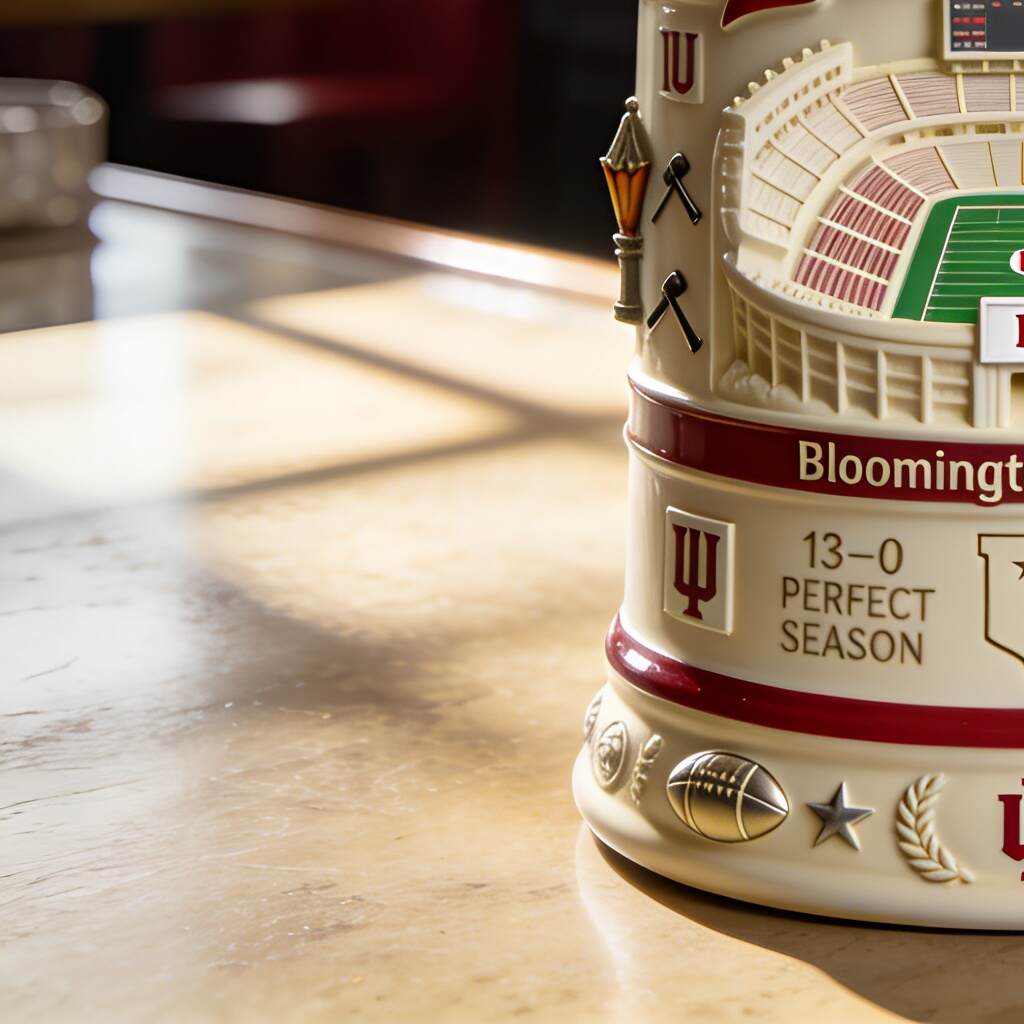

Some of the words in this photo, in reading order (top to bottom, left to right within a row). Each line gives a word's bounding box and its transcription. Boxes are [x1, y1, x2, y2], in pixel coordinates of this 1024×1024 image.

[660, 30, 699, 95] IU
[782, 576, 936, 622] PERFECT
[780, 619, 923, 665] SEASON
